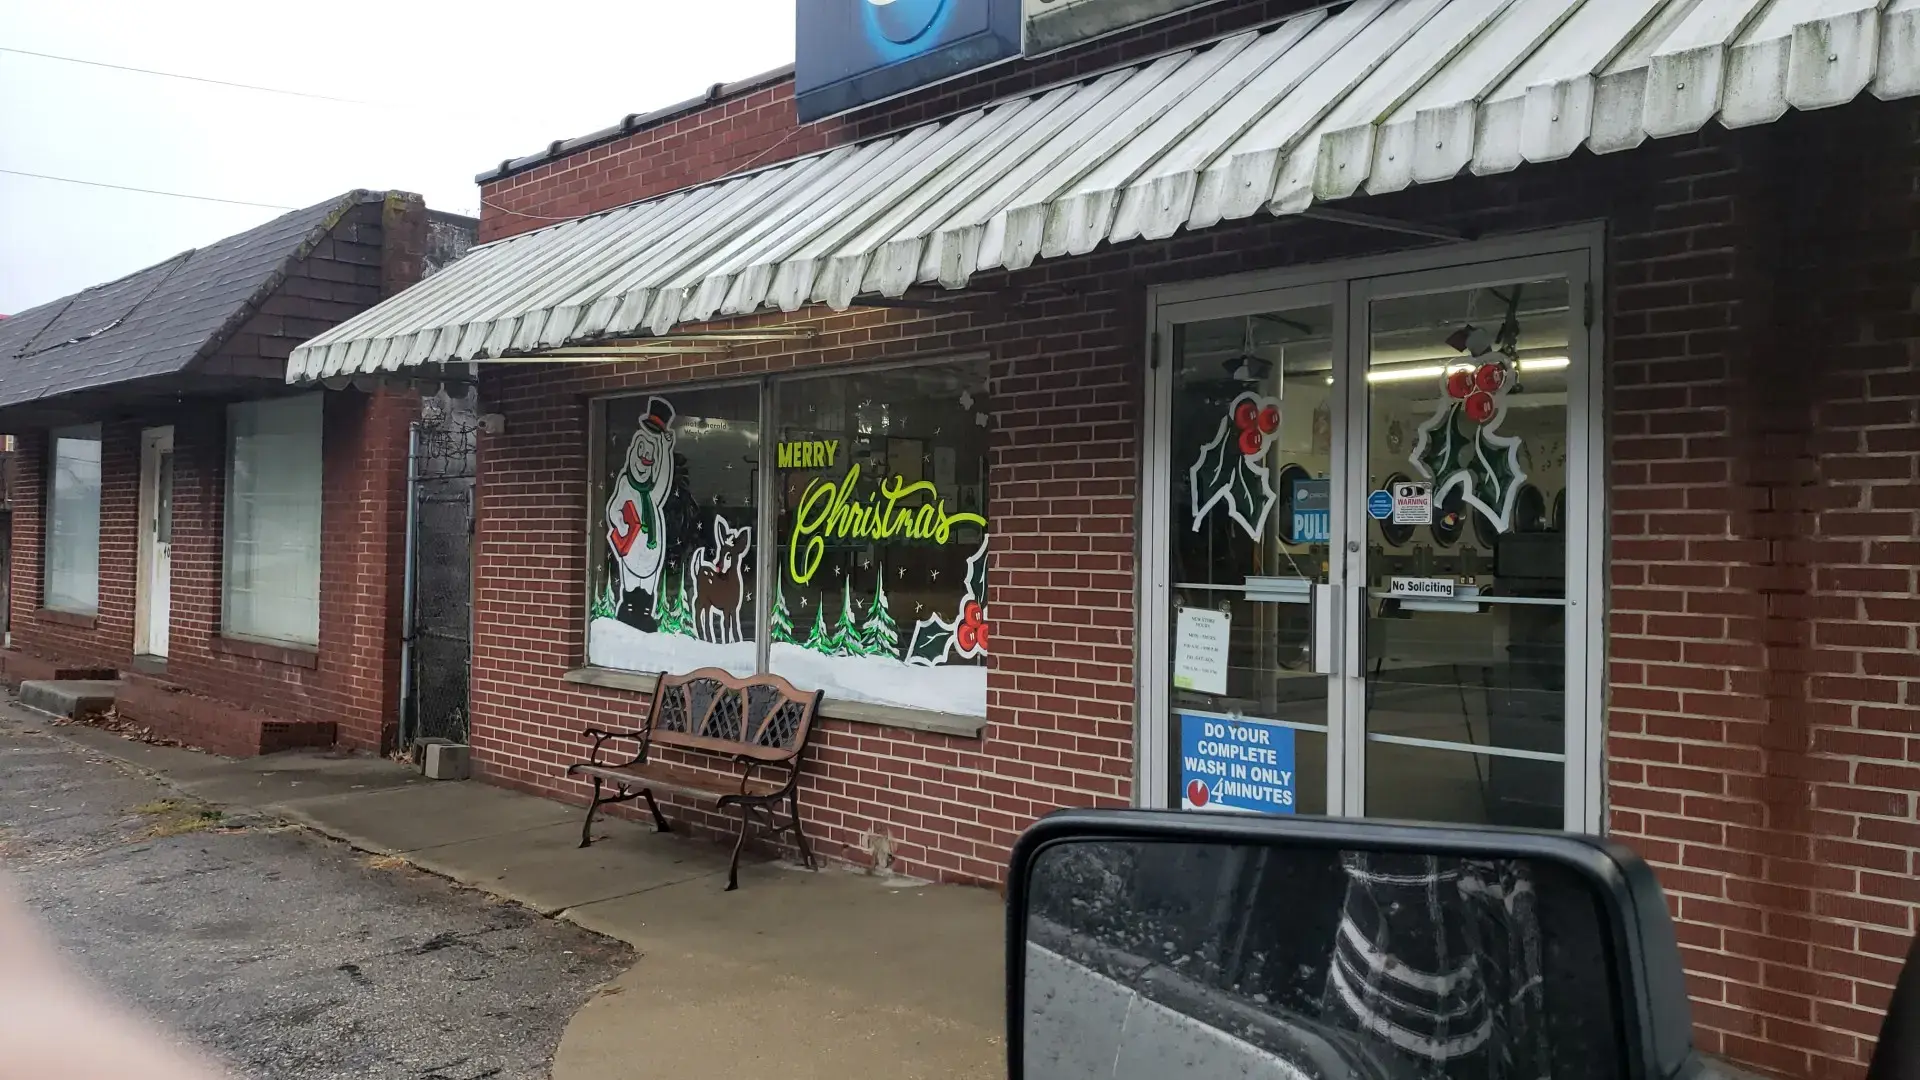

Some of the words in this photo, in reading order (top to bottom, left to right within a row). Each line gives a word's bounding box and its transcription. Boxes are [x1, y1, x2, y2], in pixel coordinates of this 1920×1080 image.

[778, 440, 838, 468] MERRY
[1397, 498, 1428, 506] WARNING
[790, 463, 988, 586] Christmas
[1294, 513, 1330, 540] PULL
[1392, 580, 1405, 591] No
[1407, 580, 1452, 595] Soliciting
[1204, 722, 1225, 739] DO
[1227, 725, 1270, 745] YOUR
[1197, 740, 1277, 765] COMPLETE
[1184, 756, 1227, 777] WASH
[1231, 763, 1246, 779] IN
[1250, 766, 1292, 787] ONLY
[1210, 777, 1224, 804] 4
[1224, 780, 1293, 806] MINUTES
